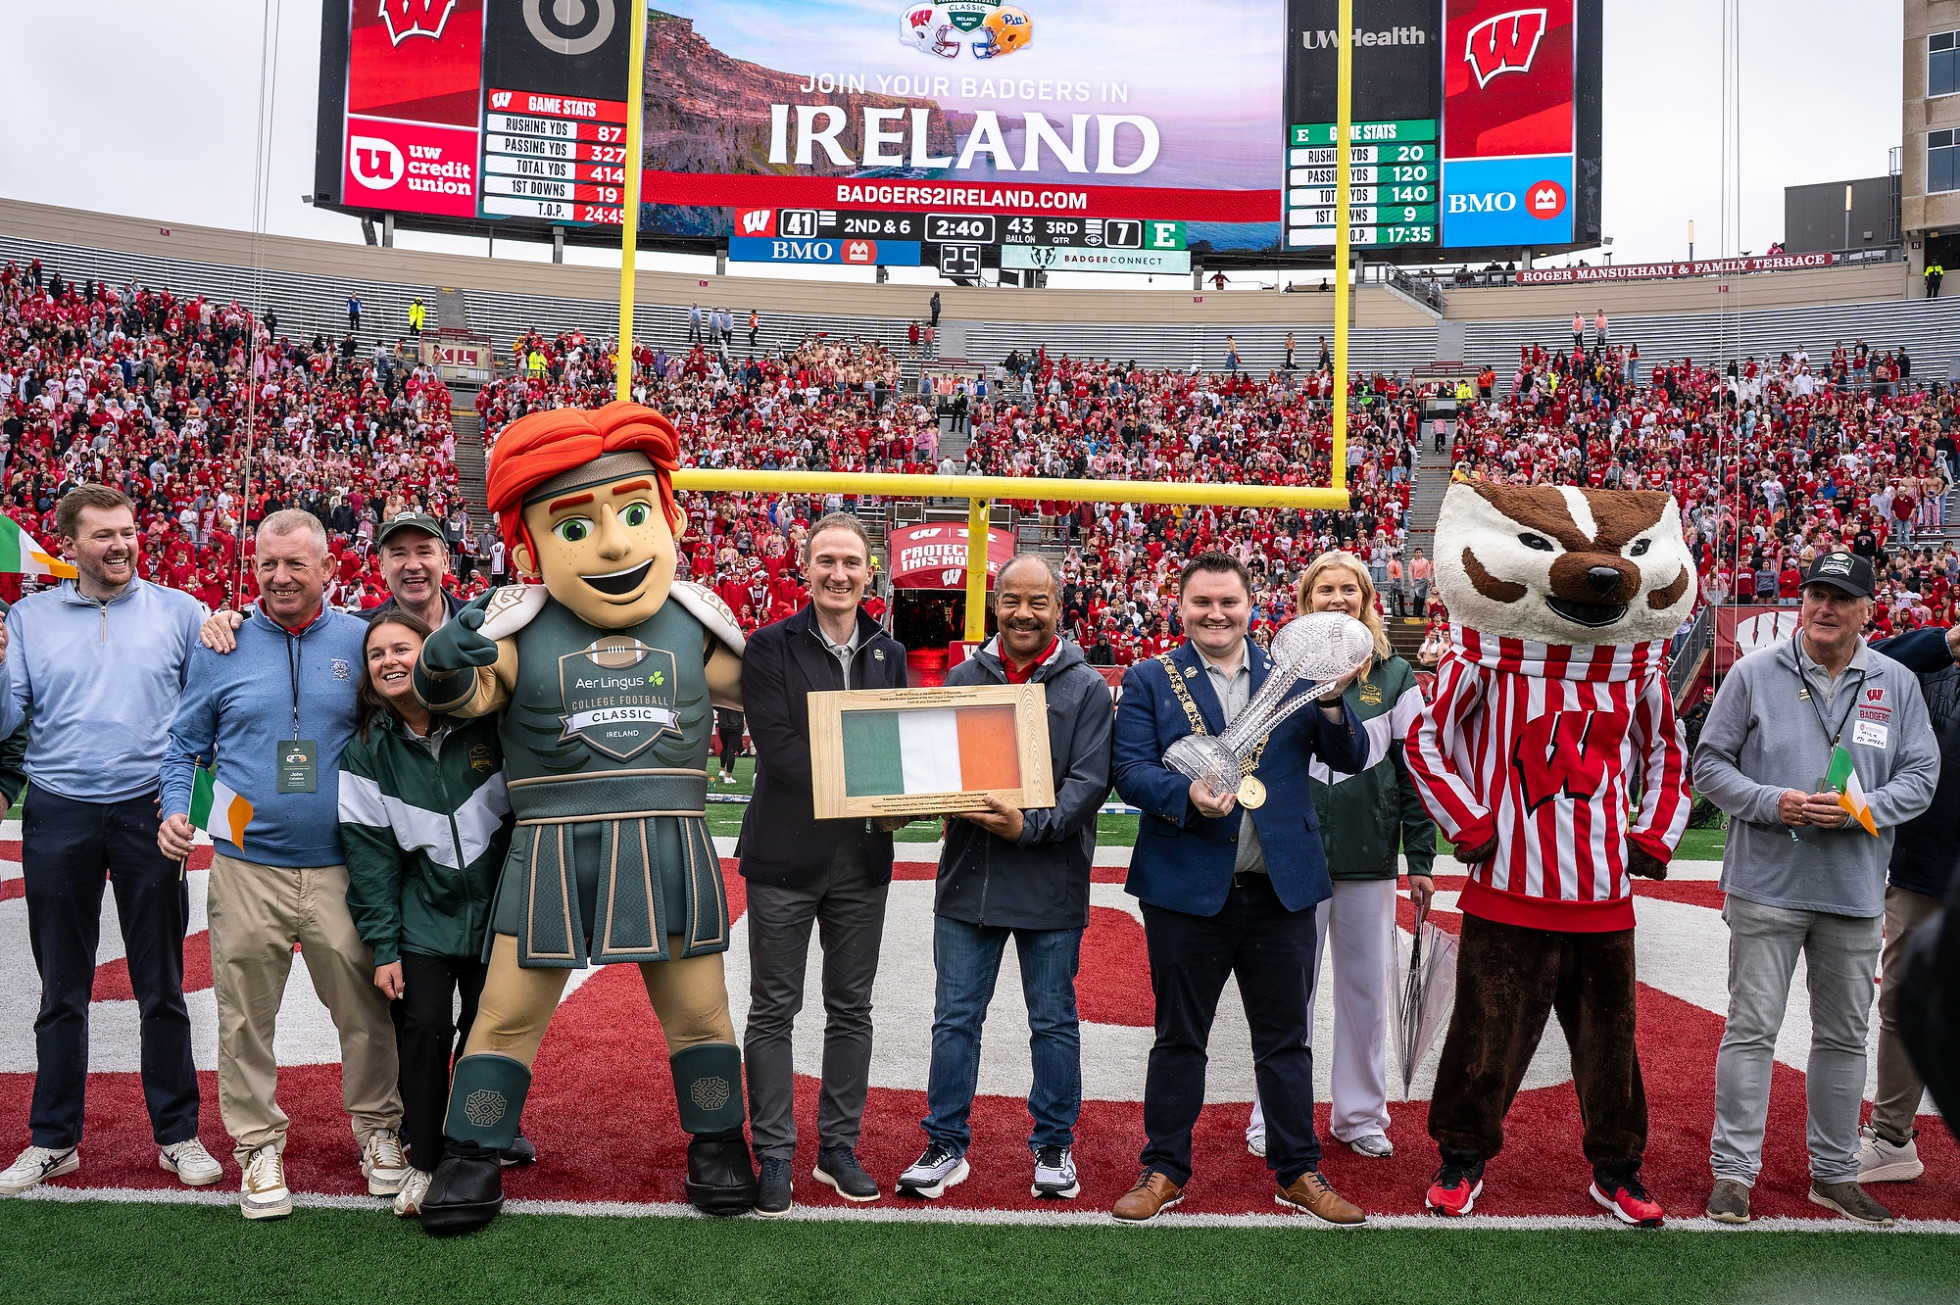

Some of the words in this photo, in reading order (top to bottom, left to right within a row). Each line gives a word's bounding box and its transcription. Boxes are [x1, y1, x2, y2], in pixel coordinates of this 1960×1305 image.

[948, 4, 986, 12] CLASSIC
[1001, 14, 1024, 26] Pitt
[800, 72, 865, 95] JOIN
[875, 75, 950, 97] YOUR
[961, 77, 1090, 102] BADGERS
[1101, 82, 1128, 103] IN
[528, 95, 561, 115] GAME
[563, 98, 597, 118] STATS
[506, 117, 546, 133] RUSHING
[549, 121, 568, 136] YDS
[597, 126, 622, 142] 87
[1296, 129, 1309, 142] E
[1329, 125, 1362, 141] GME
[1363, 124, 1397, 140] STATS
[768, 104, 1160, 175] IRELAND
[408, 144, 442, 160] uw
[505, 138, 546, 154] PASSING
[549, 141, 567, 157] YDS
[591, 145, 627, 164] 327
[1308, 149, 1338, 163] RUSHI
[1350, 149, 1369, 161] YDS
[1397, 146, 1424, 161] 20
[408, 161, 472, 180] credit
[516, 159, 546, 174] TOTAL
[548, 162, 567, 177] YDS
[590, 166, 625, 183] 414
[1307, 169, 1338, 183] PASSI
[1350, 168, 1368, 181] YDS
[1393, 166, 1428, 181] 120
[407, 176, 472, 197] union
[511, 180, 527, 194] 1ST
[530, 181, 566, 198] DOWNS
[596, 186, 618, 203] 19
[1320, 190, 1337, 203] TOT
[1350, 188, 1368, 202] YDS
[1391, 186, 1428, 201] 140
[837, 185, 1087, 210] BADGERS2IRELAND.COM
[1447, 191, 1517, 214] BMO
[538, 203, 565, 218] T.O.P.
[584, 206, 625, 225] 24:45
[1315, 211, 1331, 223] 1ST
[1403, 206, 1417, 222] 9
[786, 212, 813, 236] 41
[844, 218, 882, 233] 2ND
[884, 219, 898, 233] &
[900, 219, 911, 234] 6
[936, 220, 985, 237] 2:40
[1007, 218, 1034, 234] 43
[1046, 221, 1078, 235] 3RD
[1006, 234, 1023, 244] BALL
[1024, 235, 1036, 244] ON
[1052, 236, 1070, 245] QTR
[1116, 223, 1130, 246] 7
[1153, 222, 1176, 248] E
[1349, 229, 1368, 242] O.P.
[1387, 226, 1432, 243] 17:35
[771, 241, 833, 261] BMO
[943, 246, 978, 275] 25
[1064, 254, 1163, 266] BADGERCONNECT
[1522, 269, 1573, 283] ROGER
[1576, 263, 1674, 281] MANSUKHANI
[1677, 264, 1690, 275] &
[1693, 258, 1750, 273] FAMILY
[1752, 253, 1826, 270] TERRACE
[463, 350, 472, 362] L
[1430, 382, 1440, 393] M
[901, 555, 939, 572] THIS
[942, 555, 998, 573] HOE
[575, 677, 599, 689] Aer
[600, 676, 645, 691] Lingus
[571, 696, 615, 711] COLLEGE
[619, 694, 669, 706] FOOTBALL
[591, 709, 653, 722] CLASSIC
[1859, 709, 1891, 724] BADGERS
[606, 729, 640, 738] IRELAND
